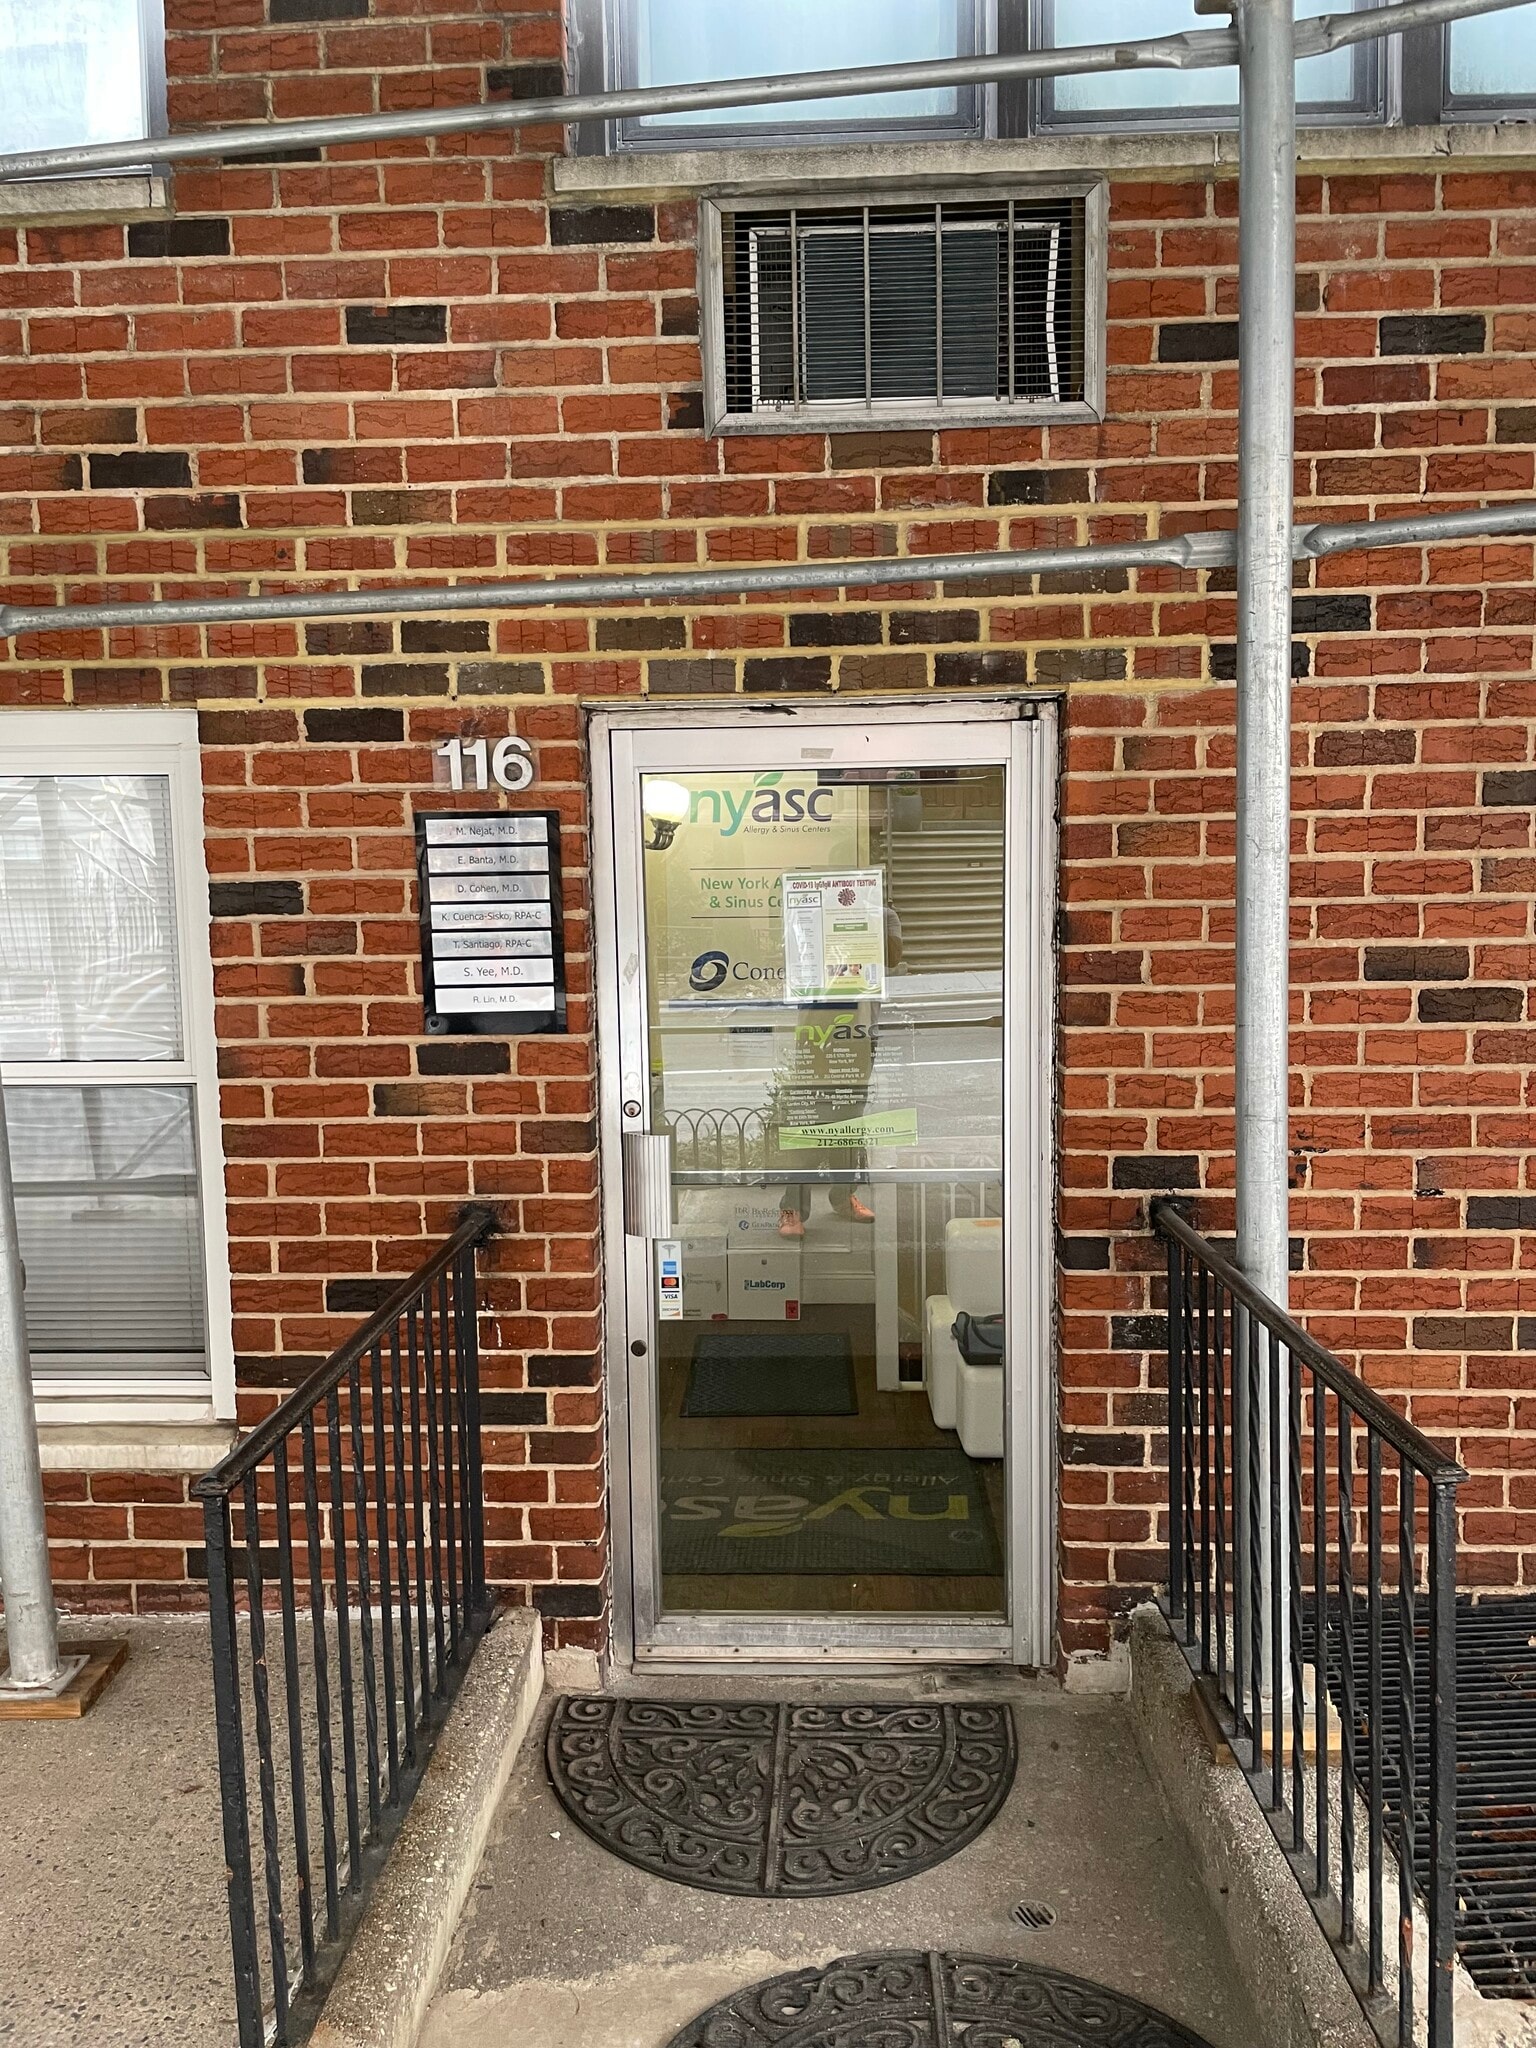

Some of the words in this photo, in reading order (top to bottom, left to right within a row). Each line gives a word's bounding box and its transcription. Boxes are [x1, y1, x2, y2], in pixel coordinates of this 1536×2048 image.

[437, 736, 533, 790] 116
[690, 788, 833, 836] nyasc
[456, 827, 466, 836] M.
[469, 826, 495, 836] Nejat,
[498, 826, 518, 835] M.D.
[743, 825, 770, 835] Allergy
[780, 825, 799, 833] Sinus
[802, 824, 831, 833] Centers
[458, 856, 466, 865] E.
[469, 856, 496, 866] Banta,
[499, 855, 519, 864] M.D.
[701, 877, 733, 890] New
[738, 877, 769, 890] York
[857, 879, 877, 887] TESTING
[457, 884, 467, 893] D.
[469, 884, 499, 894] Cohen,
[502, 884, 521, 893] M.D.
[709, 896, 720, 908] &
[726, 896, 762, 908] Sinus
[789, 896, 818, 906] nyasc
[441, 913, 450, 921] K.
[453, 912, 512, 922] Cuenca-Sisko,
[515, 911, 541, 920] RPA-C
[453, 941, 460, 949] T.
[463, 940, 503, 950] Santiago,
[506, 939, 532, 948] RPA-C
[464, 967, 473, 977] S.
[476, 967, 497, 978] Yee,
[501, 966, 523, 976] M.D.
[473, 995, 479, 1004] R.
[499, 995, 518, 1003] M.D.
[795, 1024, 880, 1046] nyasc
[801, 1126, 894, 1137] www.nyallergy.com
[817, 1138, 878, 1147] 212-686-6321
[750, 1280, 786, 1290] LabCorp
[661, 1486, 969, 1521] nyas
